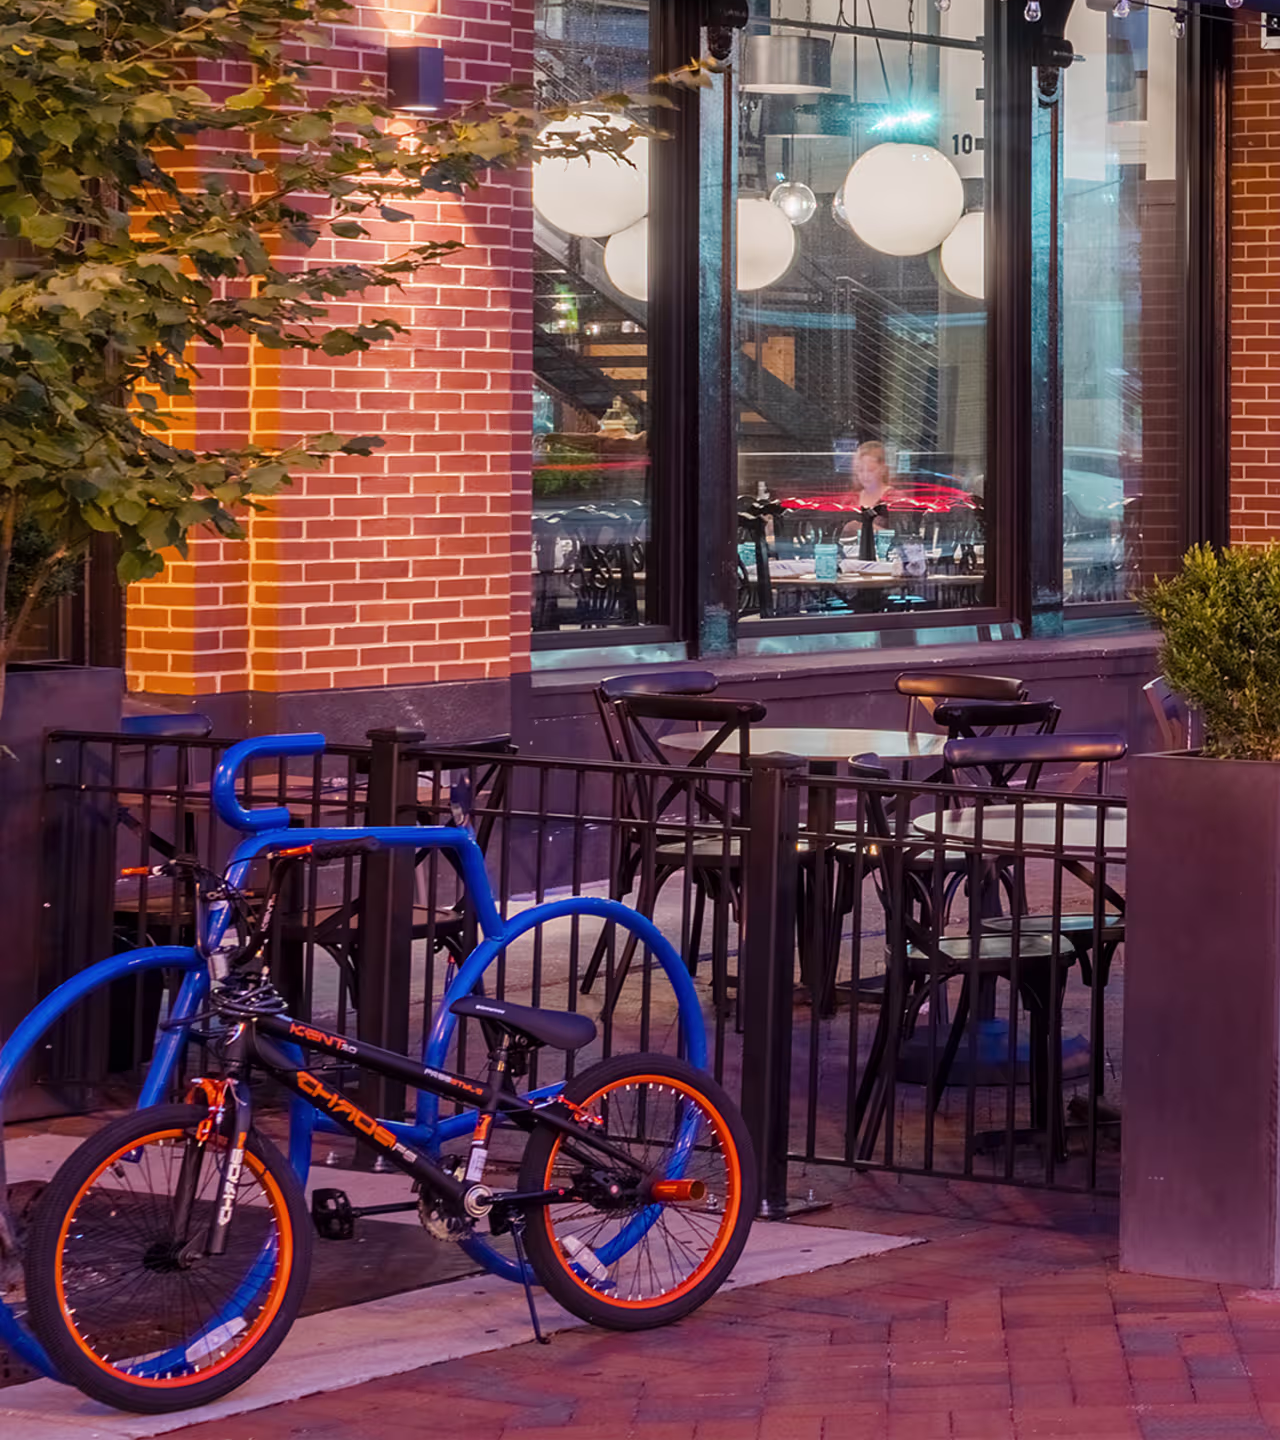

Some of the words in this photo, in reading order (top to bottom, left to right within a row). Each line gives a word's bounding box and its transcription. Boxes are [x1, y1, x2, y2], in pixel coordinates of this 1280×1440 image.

[952, 133, 973, 156] 10
[289, 1023, 348, 1051] KENT
[297, 1070, 397, 1149] CHAOS
